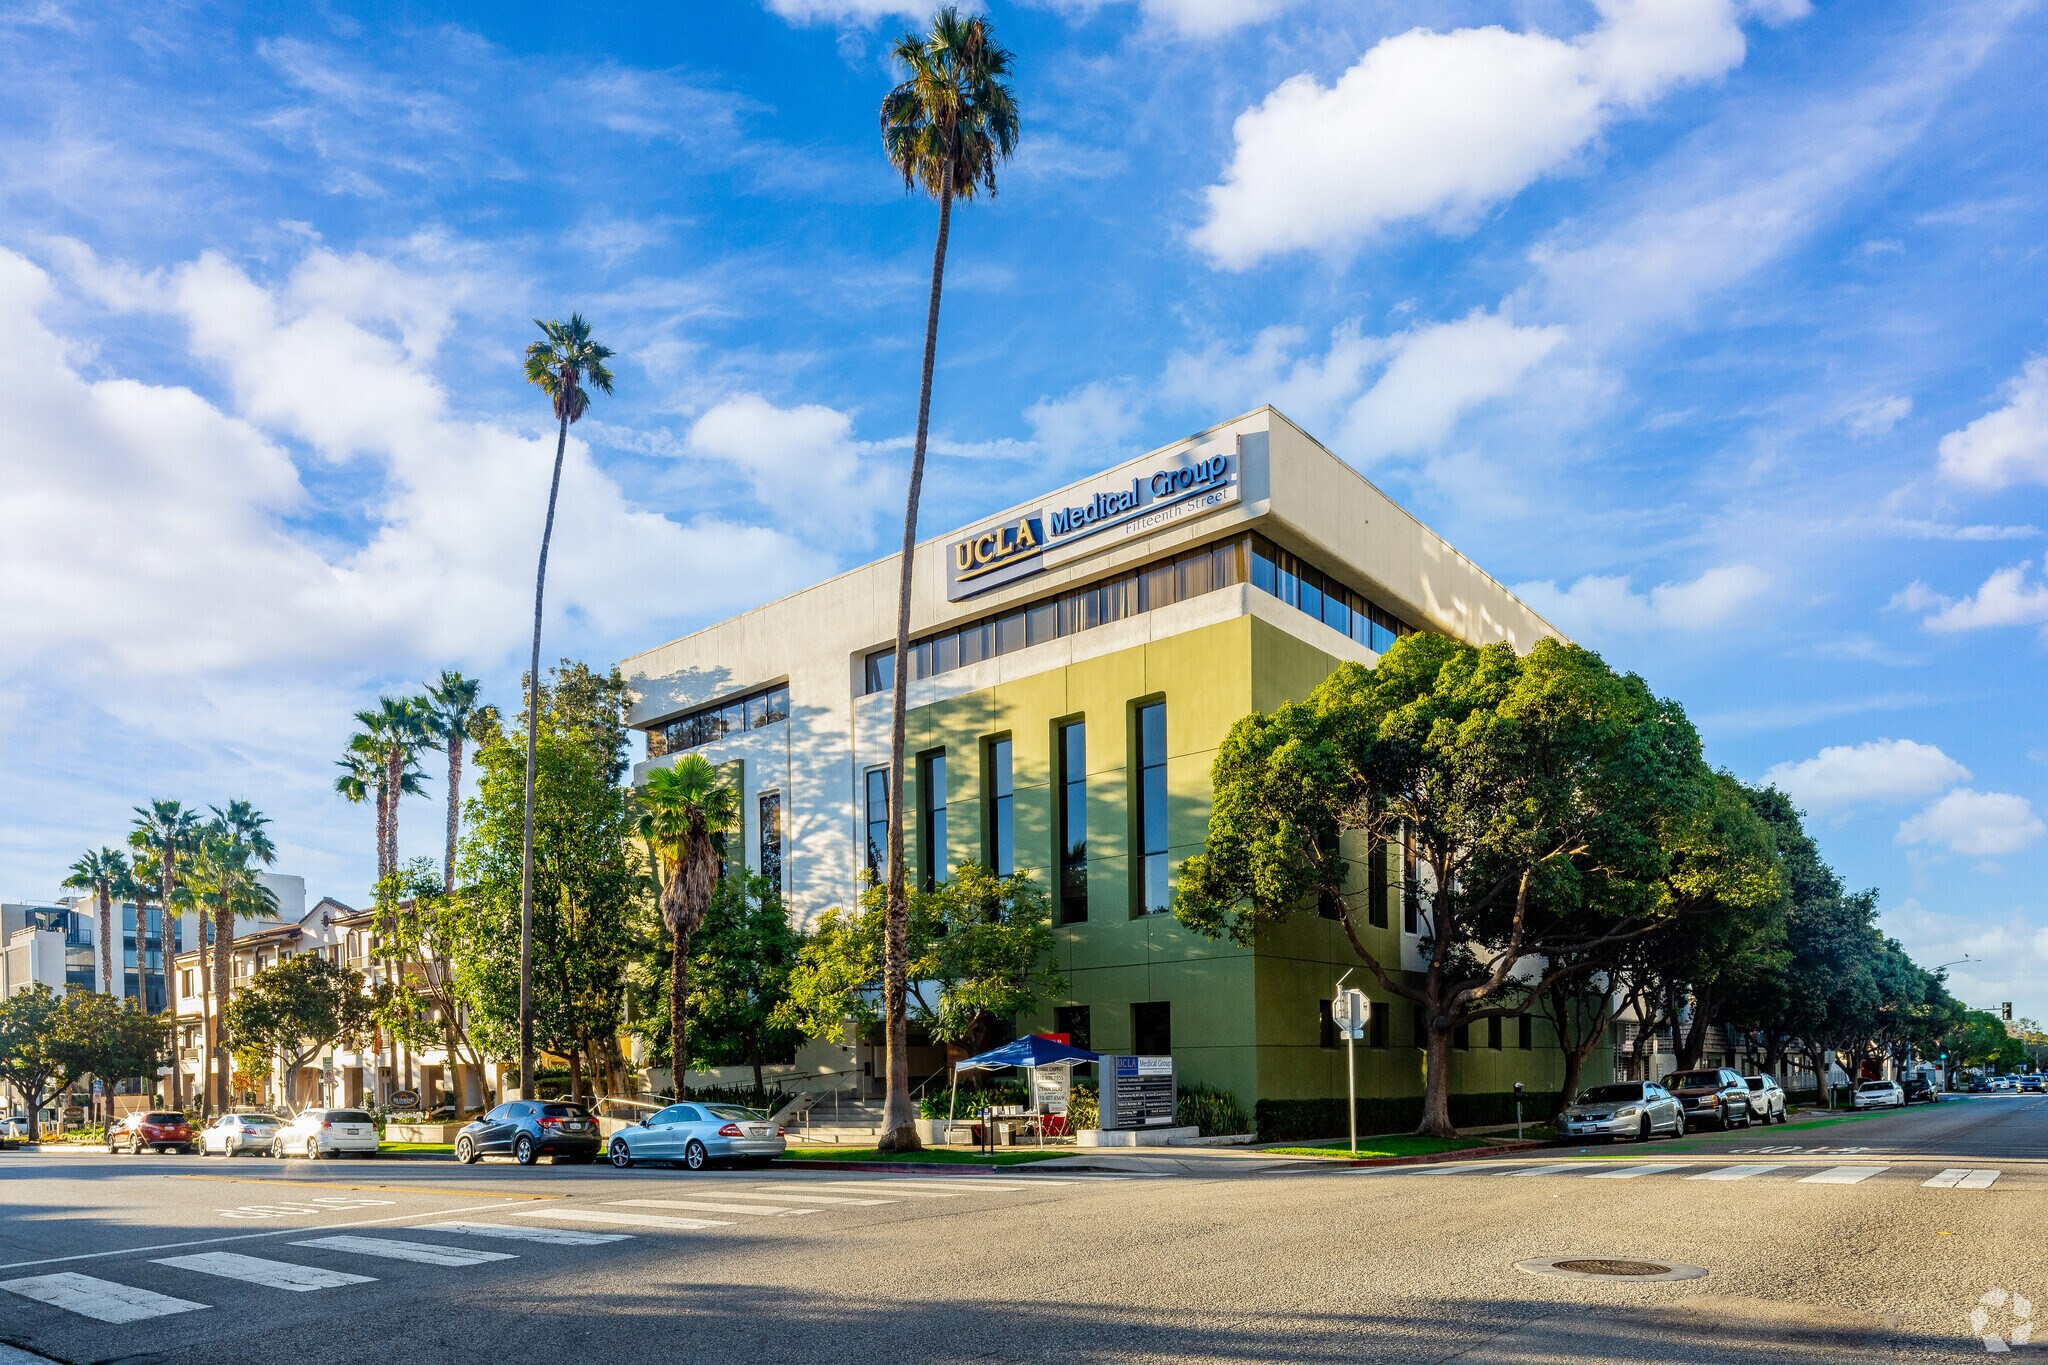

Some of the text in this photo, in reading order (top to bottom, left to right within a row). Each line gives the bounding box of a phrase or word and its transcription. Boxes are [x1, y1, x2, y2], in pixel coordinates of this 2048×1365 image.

[955, 453, 1227, 571] UCLA Medical Group
[1125, 488, 1228, 534] Fifteenth Street
[1118, 1058, 1172, 1068] UCLA Medical Group
